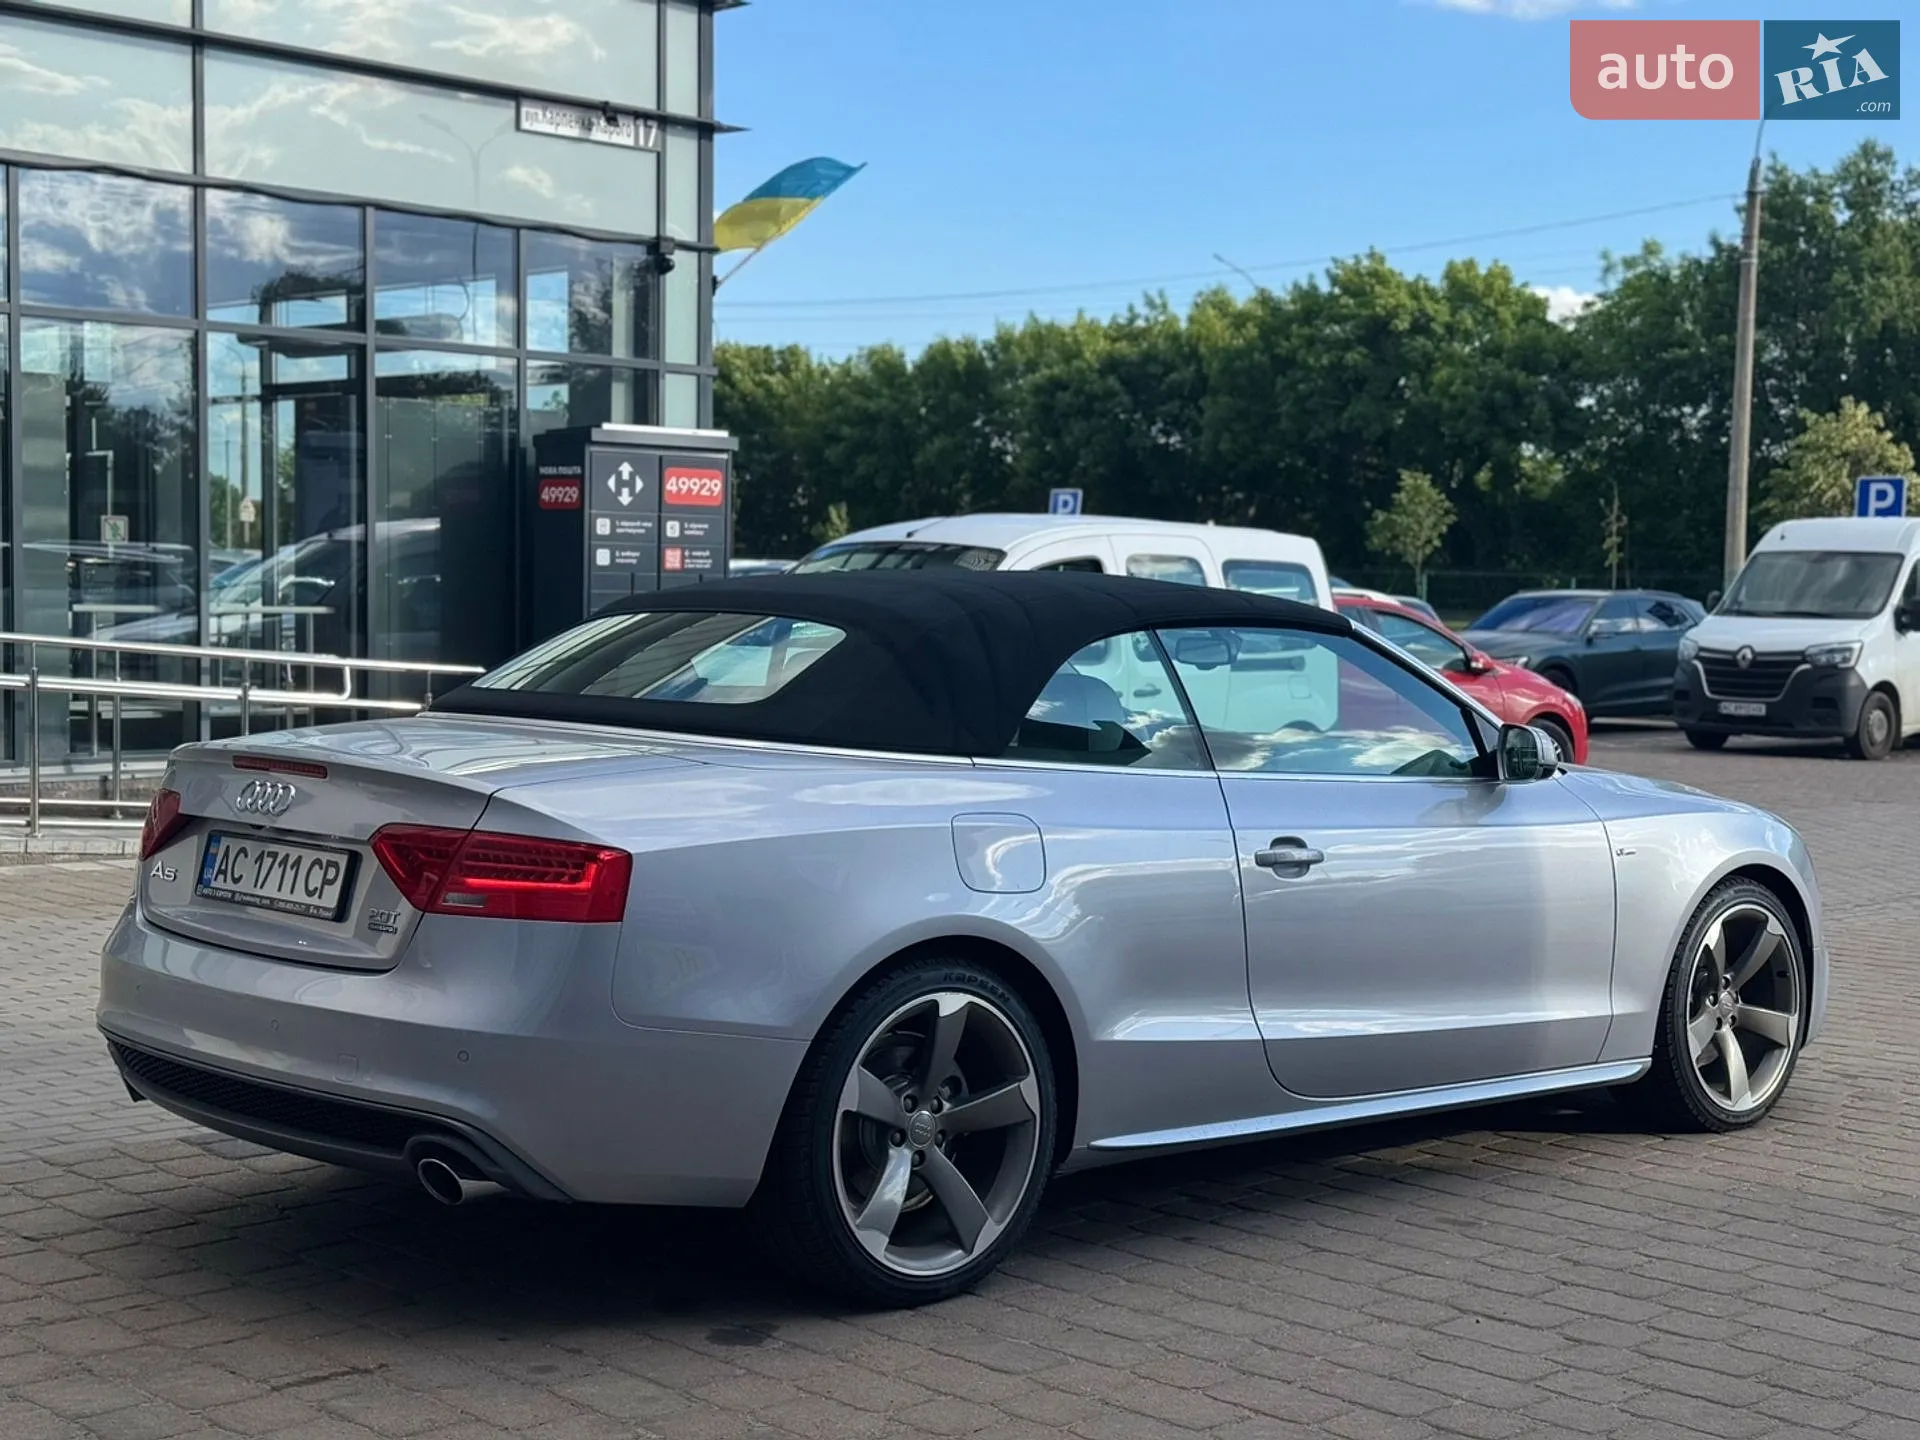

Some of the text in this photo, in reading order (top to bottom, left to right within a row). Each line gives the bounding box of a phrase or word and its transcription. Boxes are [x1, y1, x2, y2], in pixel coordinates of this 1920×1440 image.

[635, 116, 658, 148] 17
[541, 486, 579, 503] 49929
[666, 475, 722, 497] 49929
[1869, 482, 1896, 518] P
[150, 859, 177, 882] A5
[214, 844, 341, 900] AC 1711 CP
